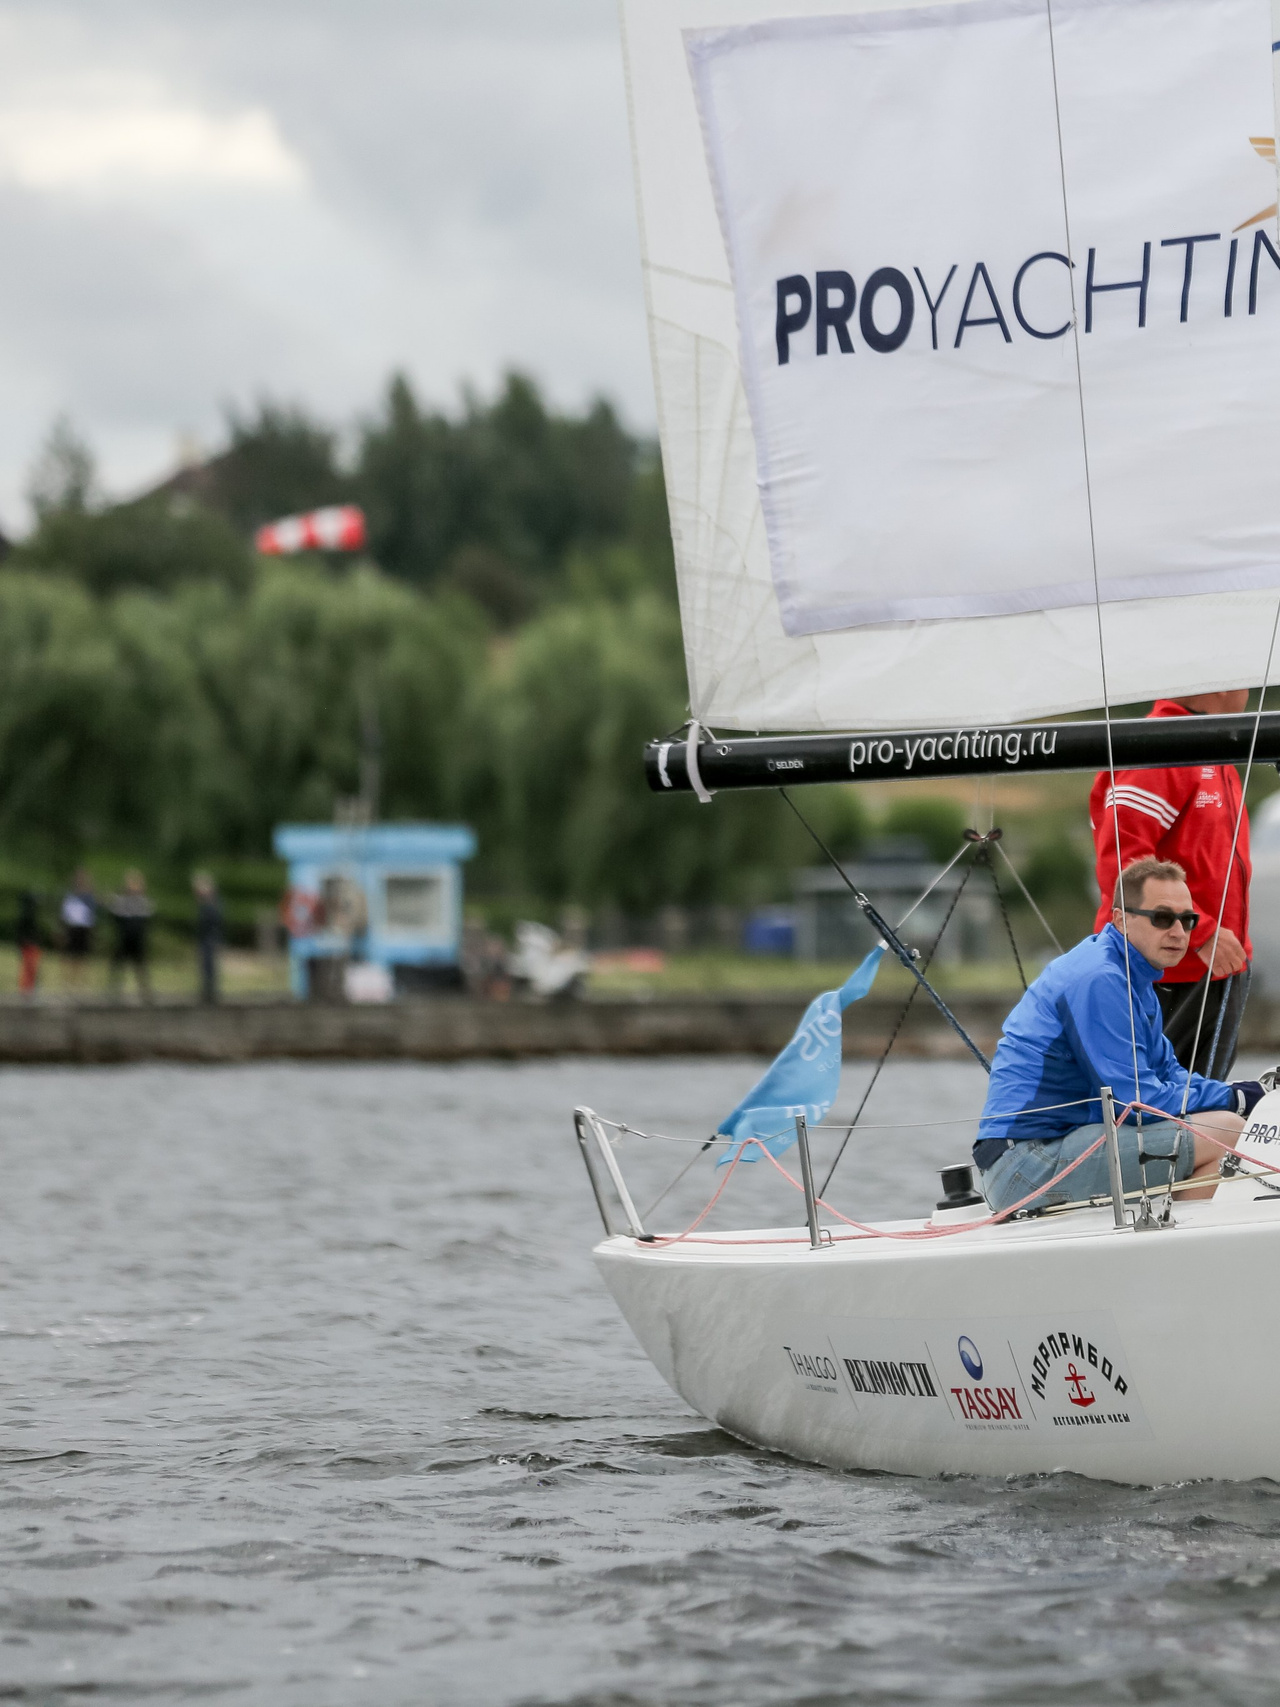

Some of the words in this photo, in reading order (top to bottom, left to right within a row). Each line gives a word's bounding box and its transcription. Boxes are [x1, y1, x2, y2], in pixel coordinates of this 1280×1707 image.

[850, 729, 1058, 773] pro-yachting.ru
[843, 1358, 938, 1397] ВЕДОМОСТИ
[1031, 1332, 1128, 1400] МОРПРИБОР
[951, 1388, 1023, 1420] TASSAY
[1053, 1414, 1106, 1426] ЛЕГЕНДАРНЫЕ
[1107, 1413, 1131, 1423] ЧАСЫ
